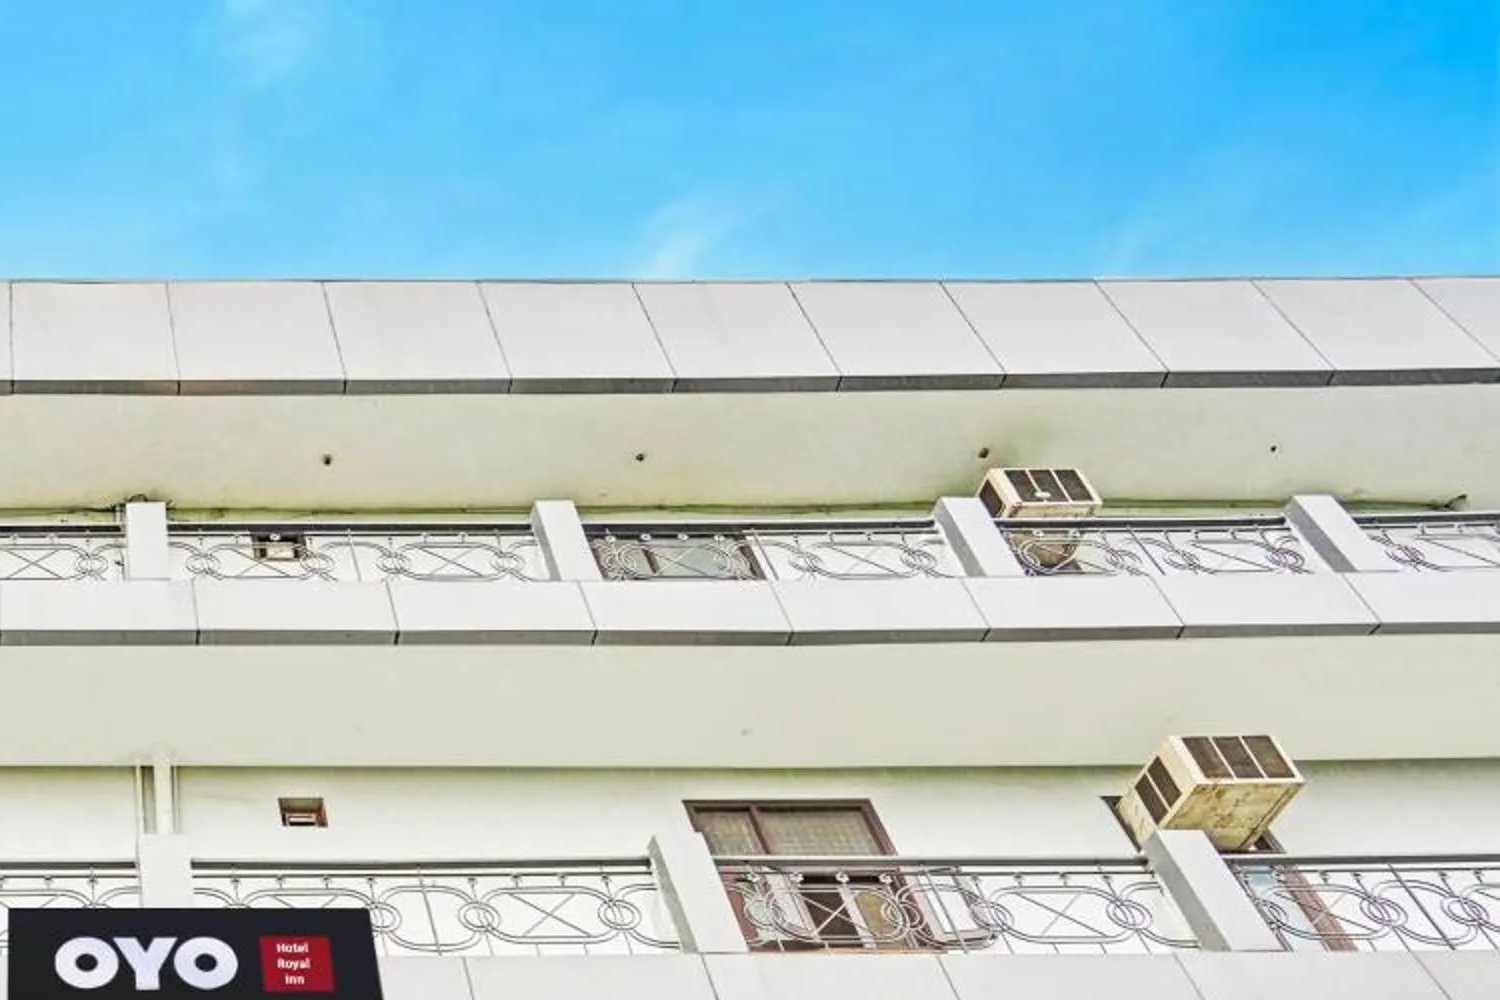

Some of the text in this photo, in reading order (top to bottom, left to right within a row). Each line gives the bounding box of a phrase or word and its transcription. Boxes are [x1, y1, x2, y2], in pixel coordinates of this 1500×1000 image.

[276, 942, 309, 953] Hotel
[54, 935, 238, 991] OYO
[277, 957, 311, 971] Royal
